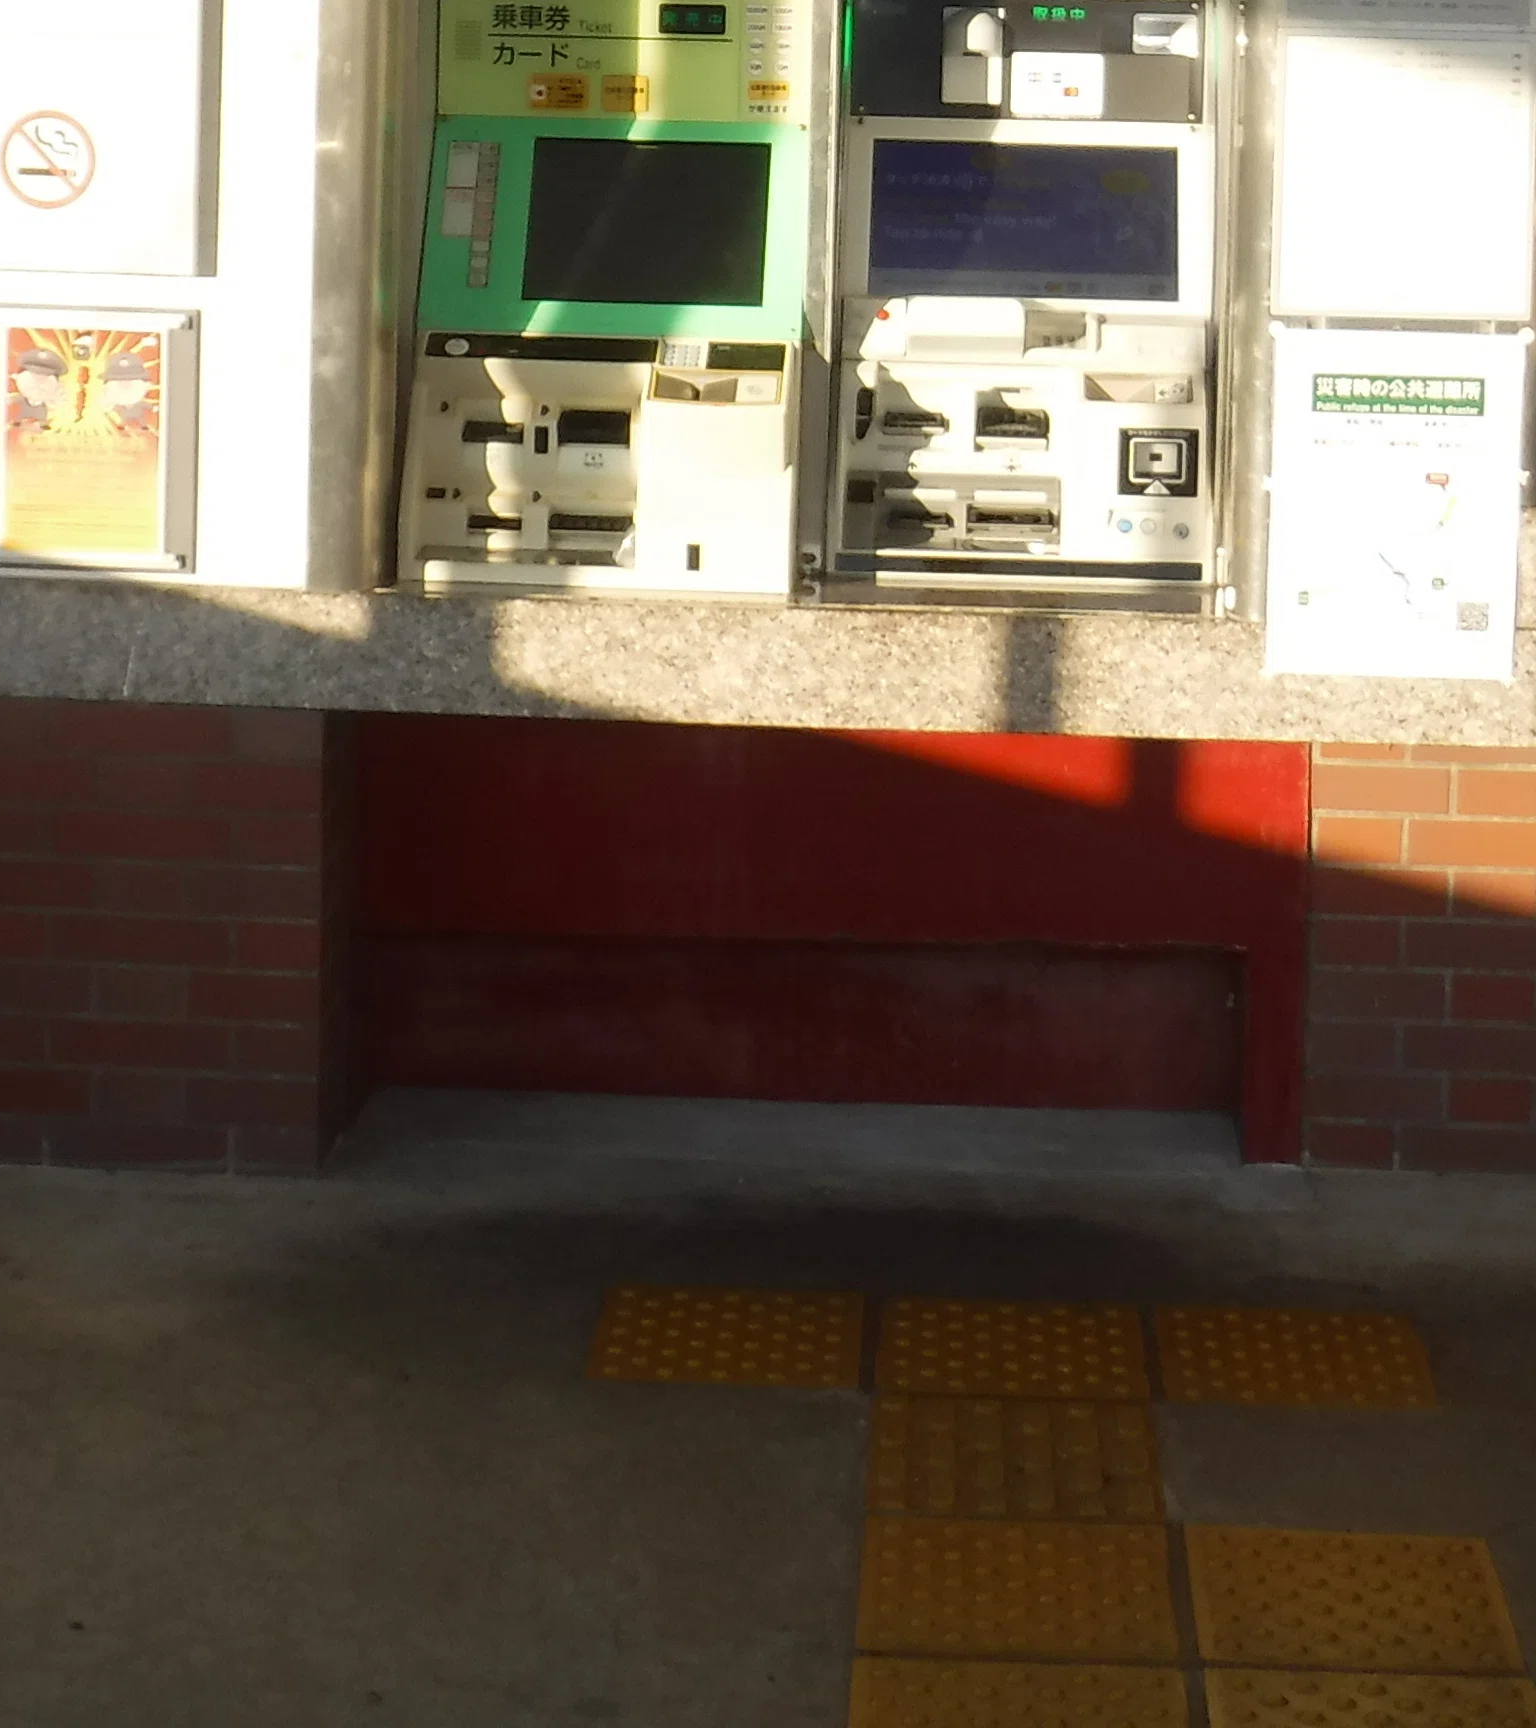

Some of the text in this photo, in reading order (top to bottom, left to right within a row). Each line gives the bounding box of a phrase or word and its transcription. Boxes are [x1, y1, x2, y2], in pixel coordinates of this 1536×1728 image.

[492, 5, 570, 30] 乗車券
[579, 20, 613, 35] Ticket
[493, 43, 570, 67] カード
[576, 56, 601, 71] Card
